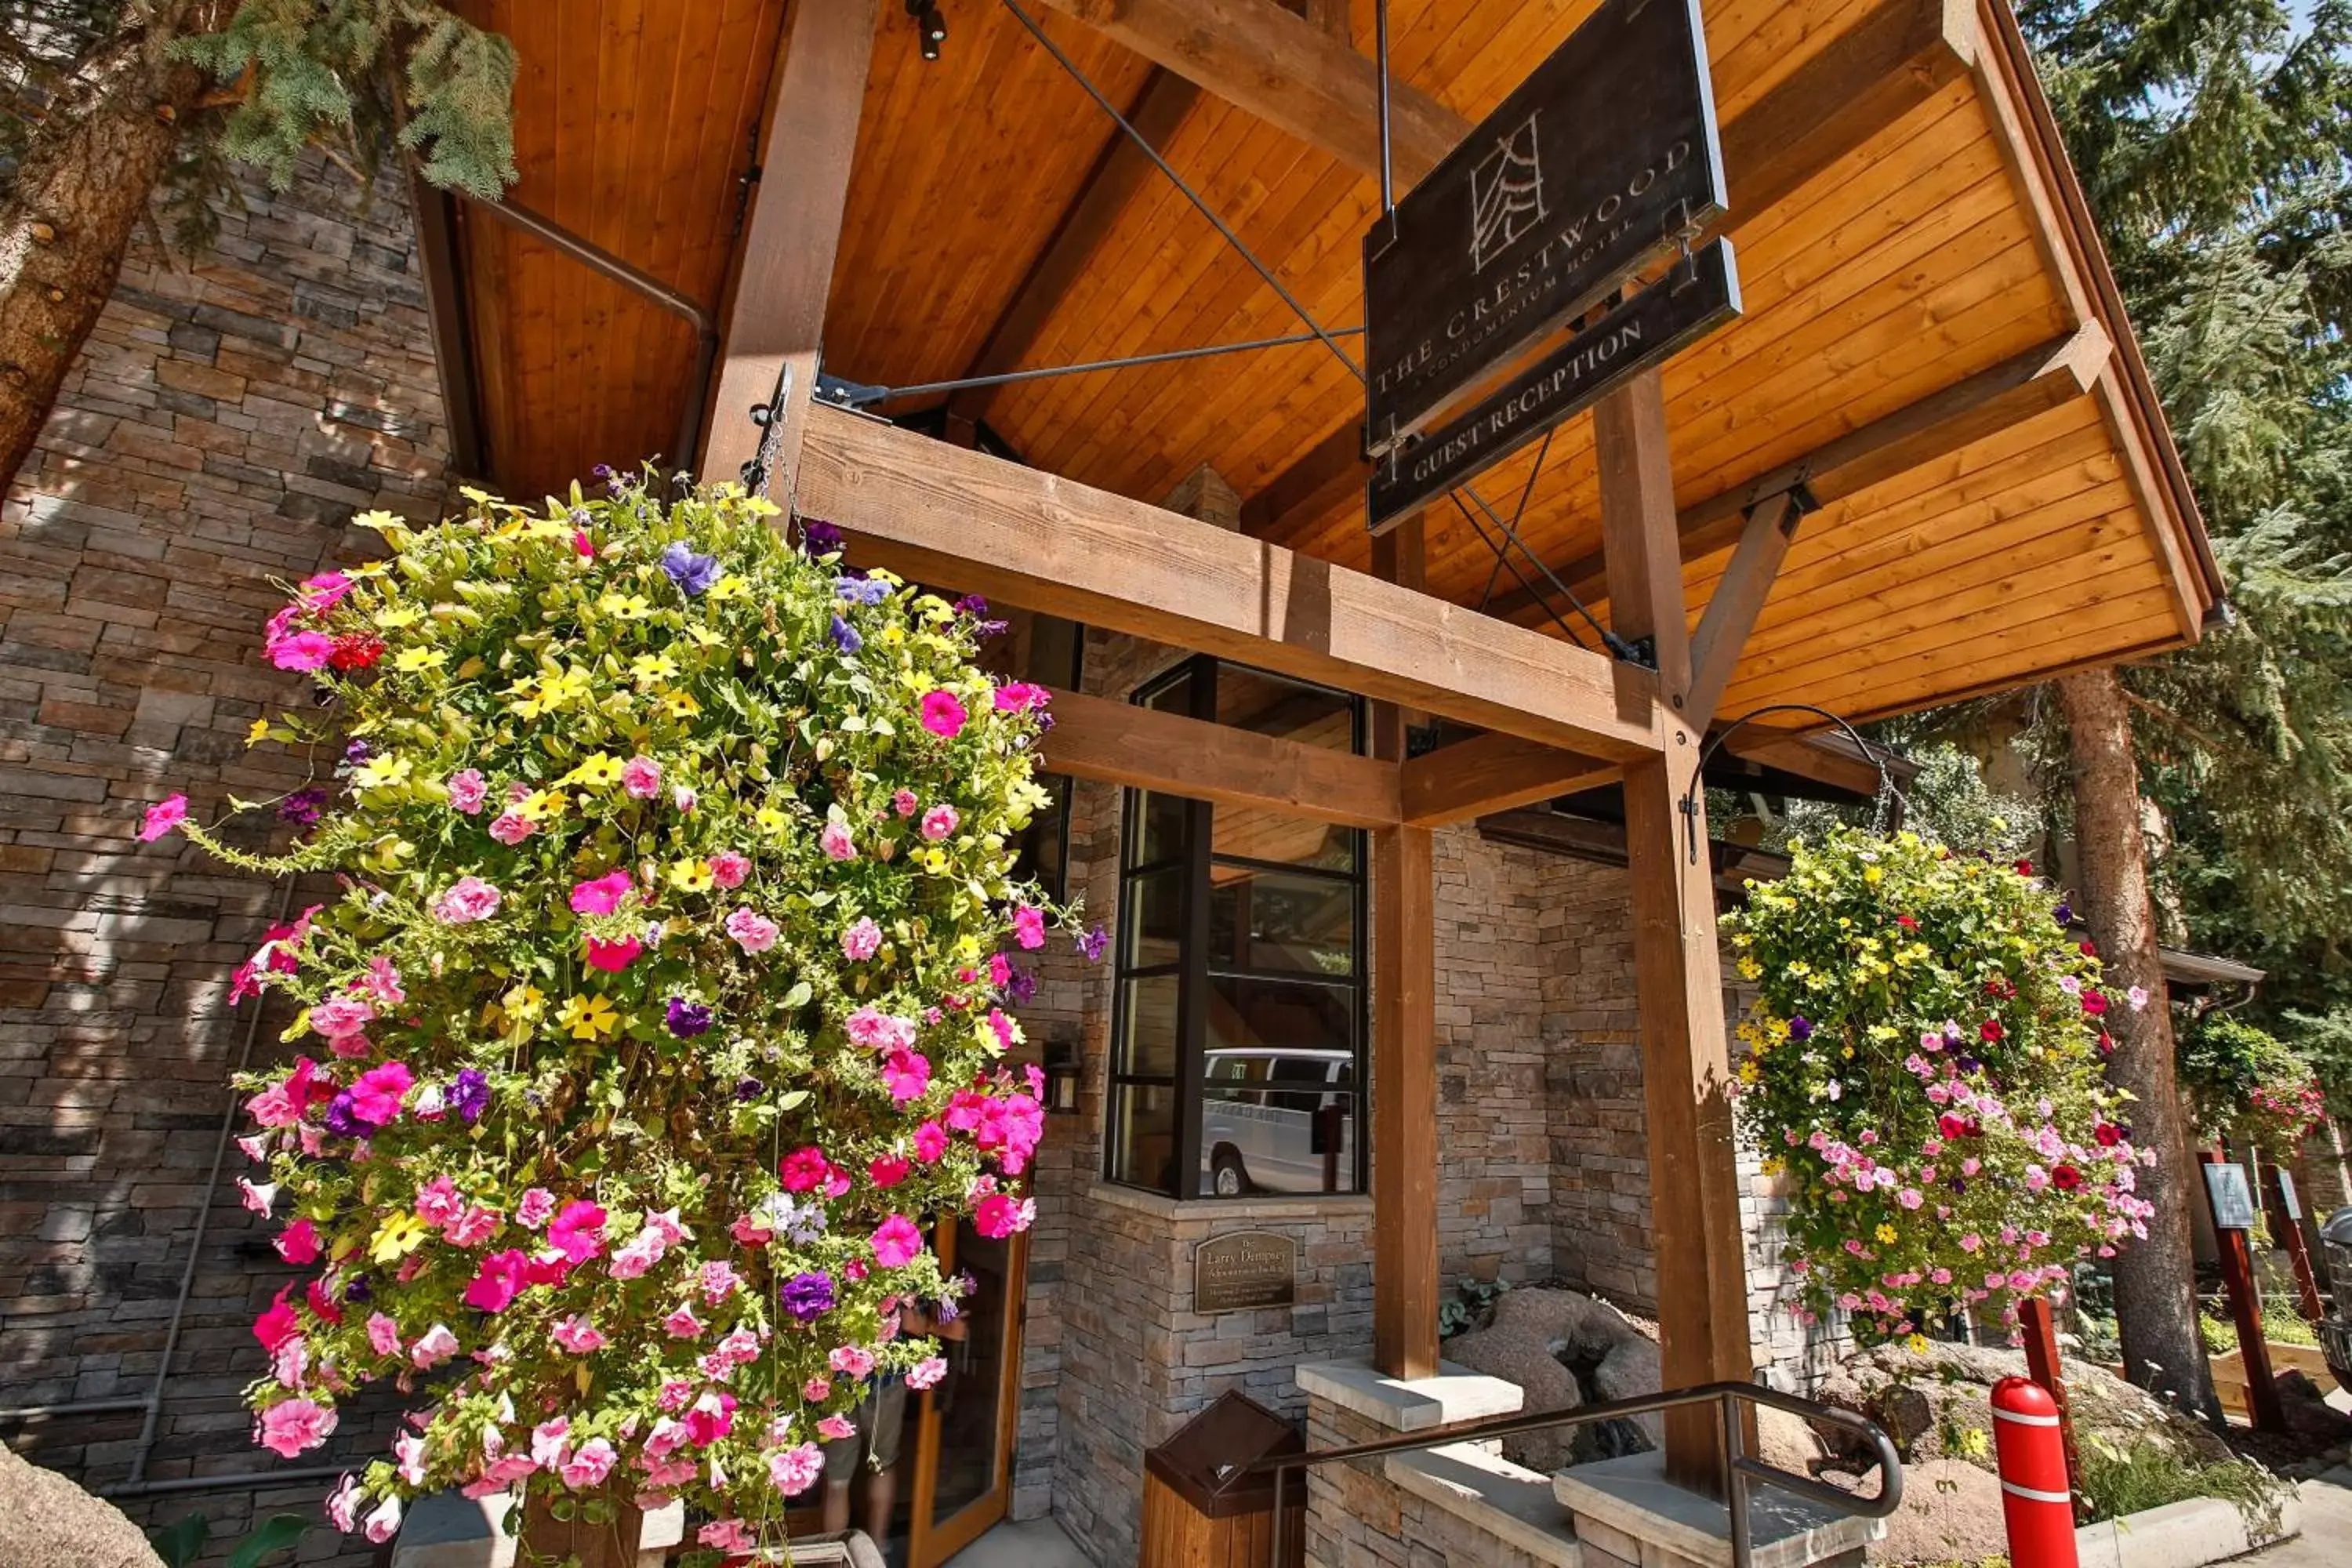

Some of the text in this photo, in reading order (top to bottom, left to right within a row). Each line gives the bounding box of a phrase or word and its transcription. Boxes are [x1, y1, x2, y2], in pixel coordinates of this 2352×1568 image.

[1377, 141, 1690, 394] THE CRESTWOOD
[1428, 276, 1556, 377] CONDOMINIUM
[1568, 219, 1633, 273] HOTEL
[1414, 320, 1642, 481] GUEST RECEPTION
[1207, 1253, 1235, 1265] Larry
